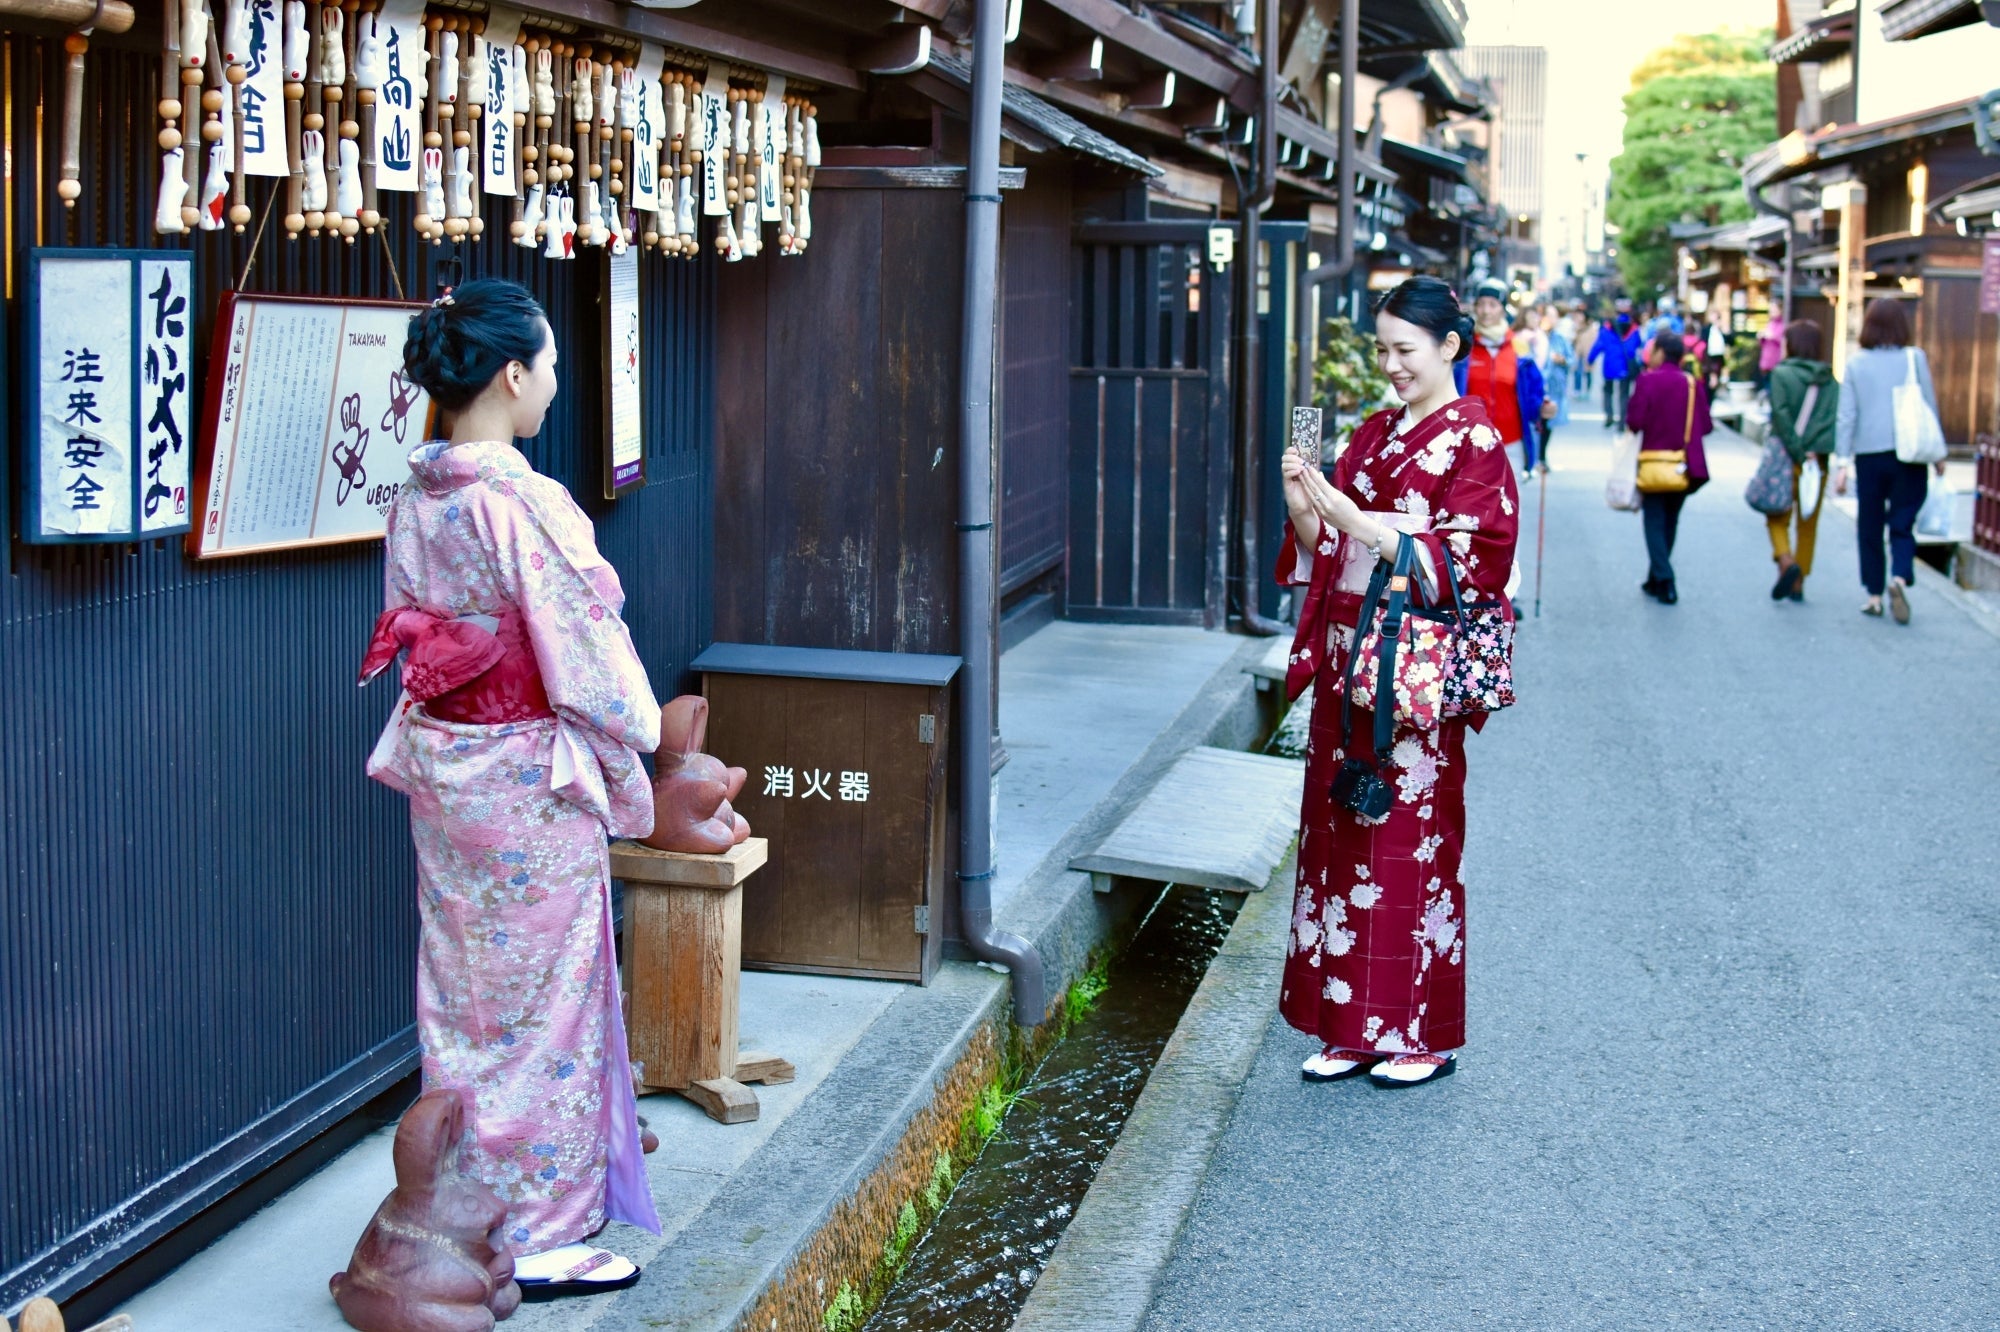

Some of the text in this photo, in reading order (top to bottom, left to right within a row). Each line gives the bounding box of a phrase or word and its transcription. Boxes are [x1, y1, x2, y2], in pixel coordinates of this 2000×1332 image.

[383, 25, 412, 171] 高山
[349, 333, 387, 348] TAKAYAMA
[60, 347, 104, 510] 往来安全
[763, 765, 870, 802] 消火器
